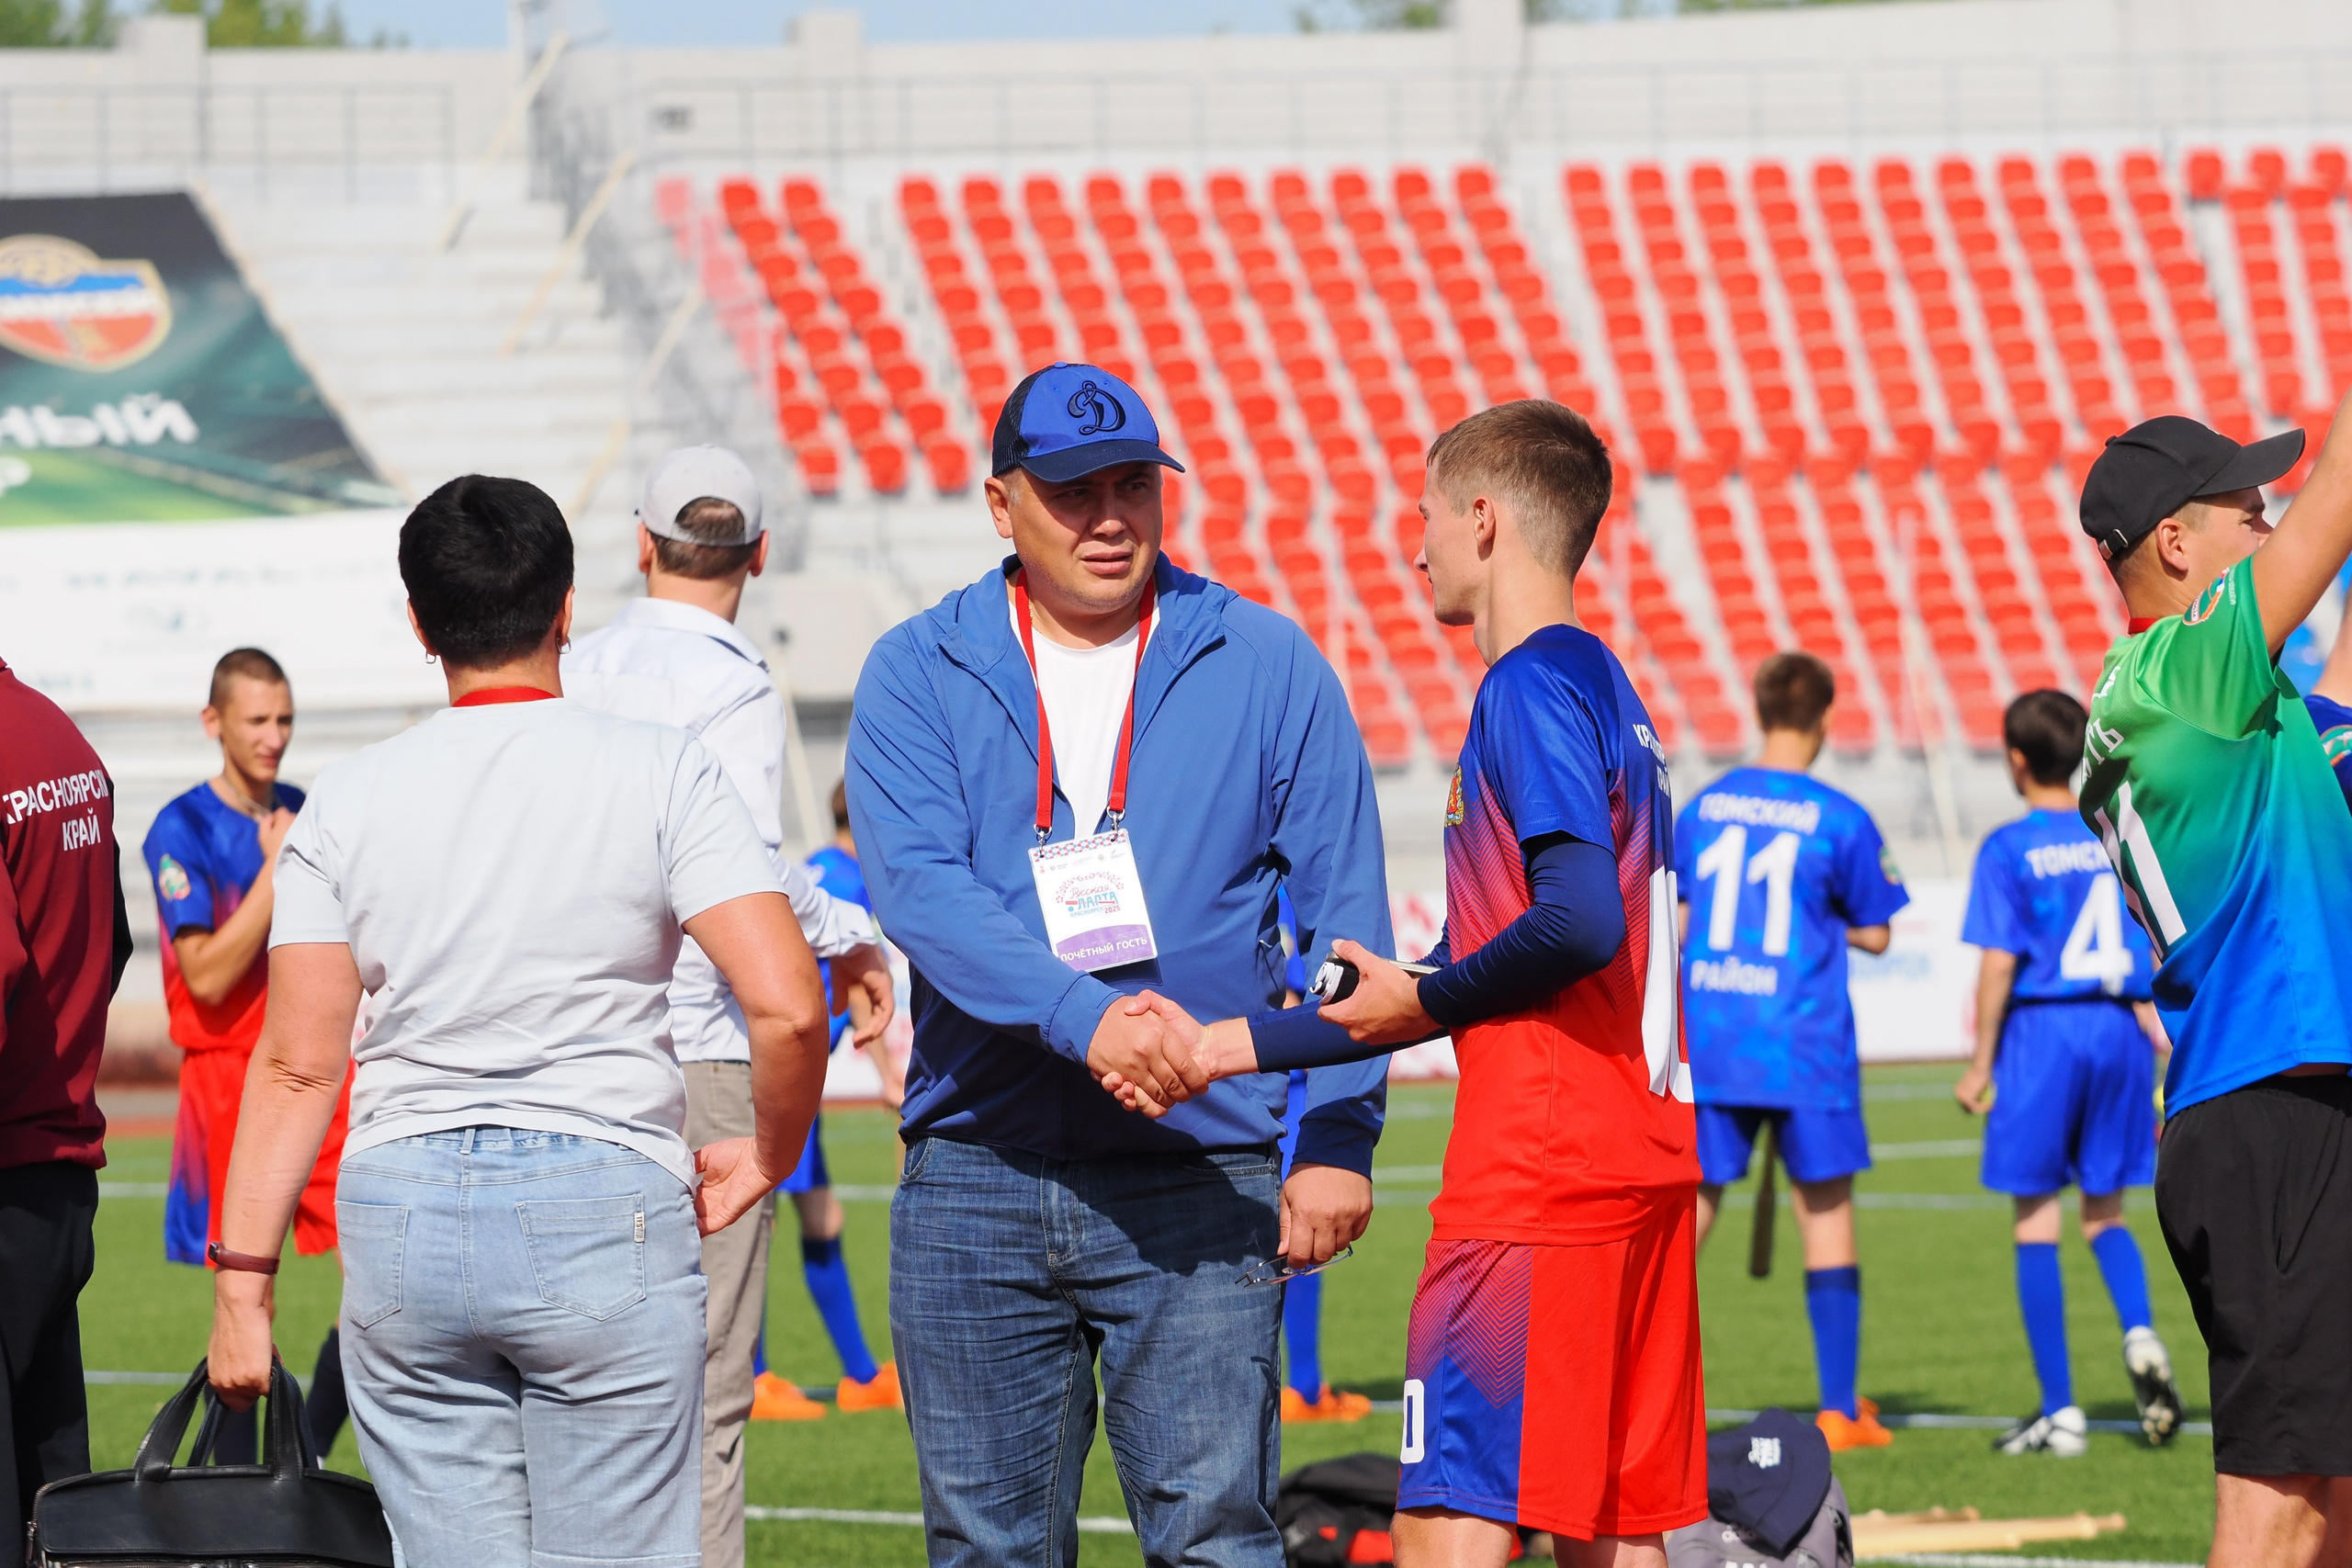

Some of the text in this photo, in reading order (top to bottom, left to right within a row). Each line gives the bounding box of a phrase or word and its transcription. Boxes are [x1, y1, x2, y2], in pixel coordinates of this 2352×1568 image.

[62, 807, 101, 851] КРАЙ
[1698, 792, 1821, 836] ТОМСКИЙ
[1078, 891, 1119, 910] ЛАПТА
[1104, 905, 1121, 914] 2025
[1696, 824, 1801, 957] 11
[1060, 937, 1148, 963] ПОЧЁТНЫЙ ГОСТЬ
[2060, 872, 2134, 998] 4
[1690, 955, 1779, 997] РАЙОН
